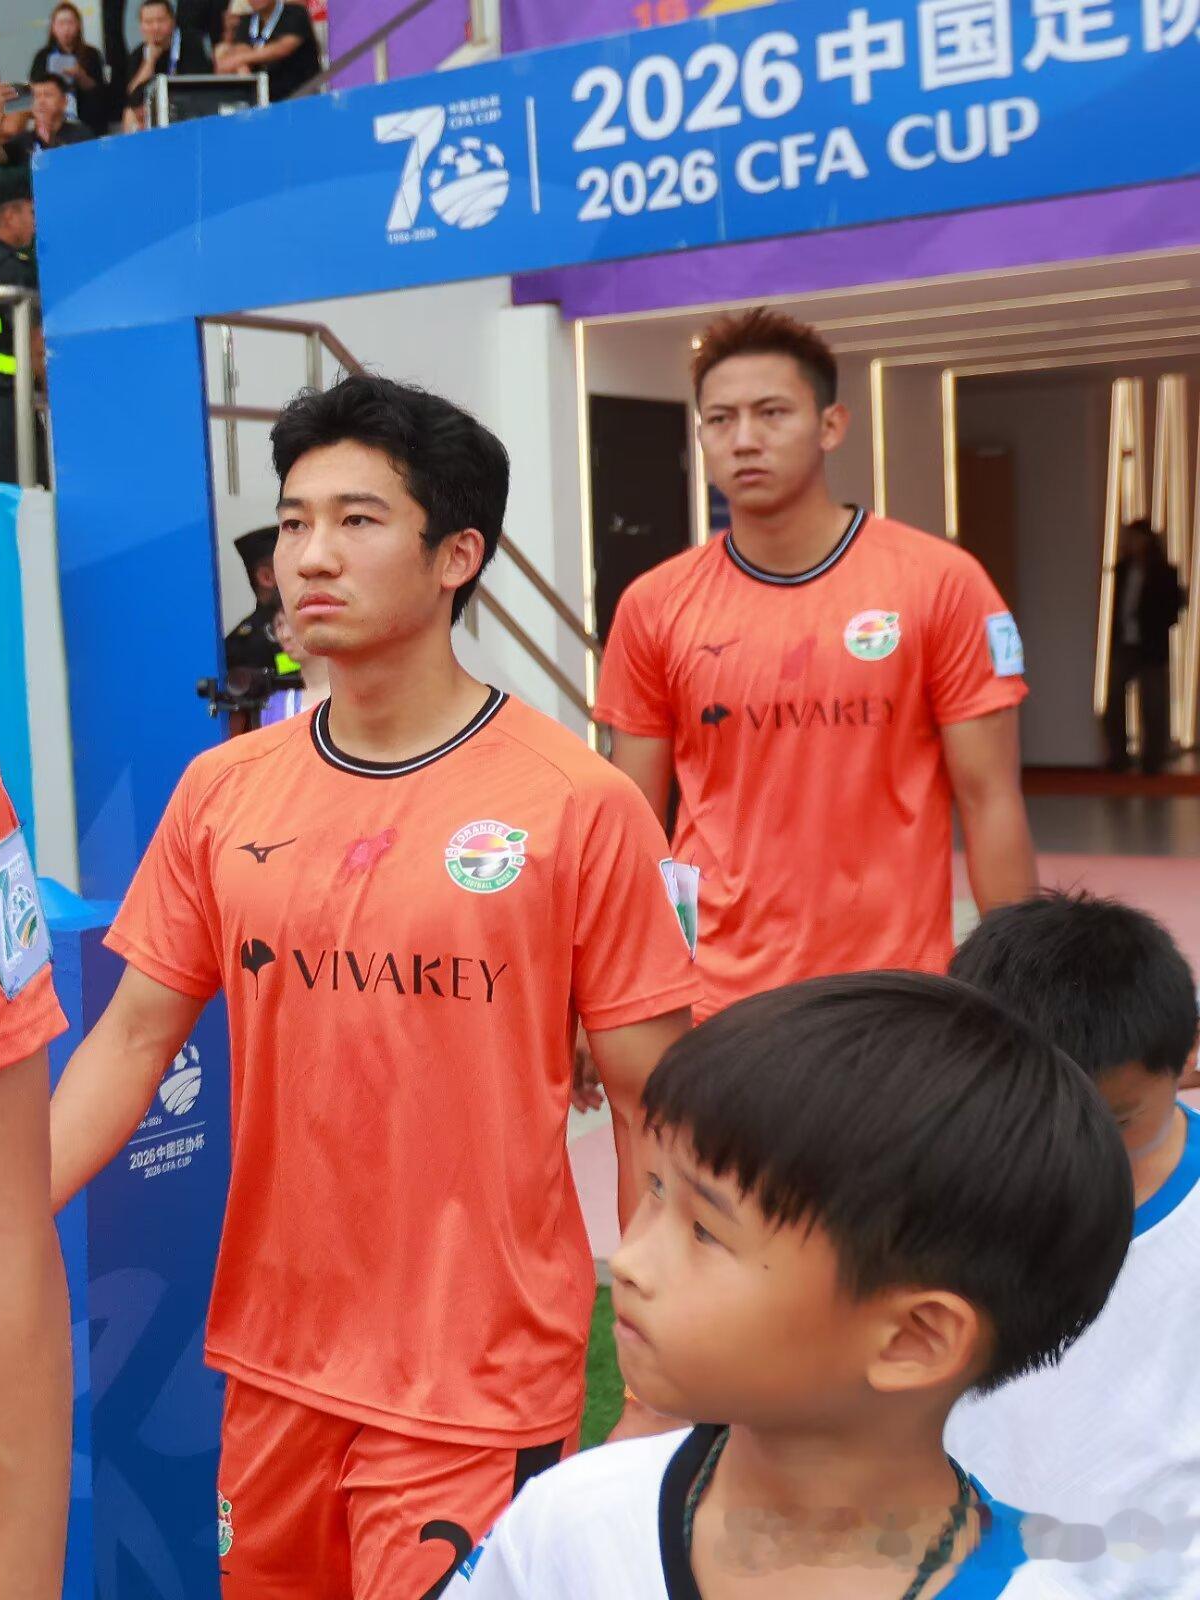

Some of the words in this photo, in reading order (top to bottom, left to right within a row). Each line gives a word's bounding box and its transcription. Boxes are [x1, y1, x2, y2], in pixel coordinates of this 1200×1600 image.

[577, 149, 718, 222] 2026
[734, 126, 870, 195] CFA
[886, 97, 1040, 170] CUP
[292, 949, 508, 1003] VIVAKEY
